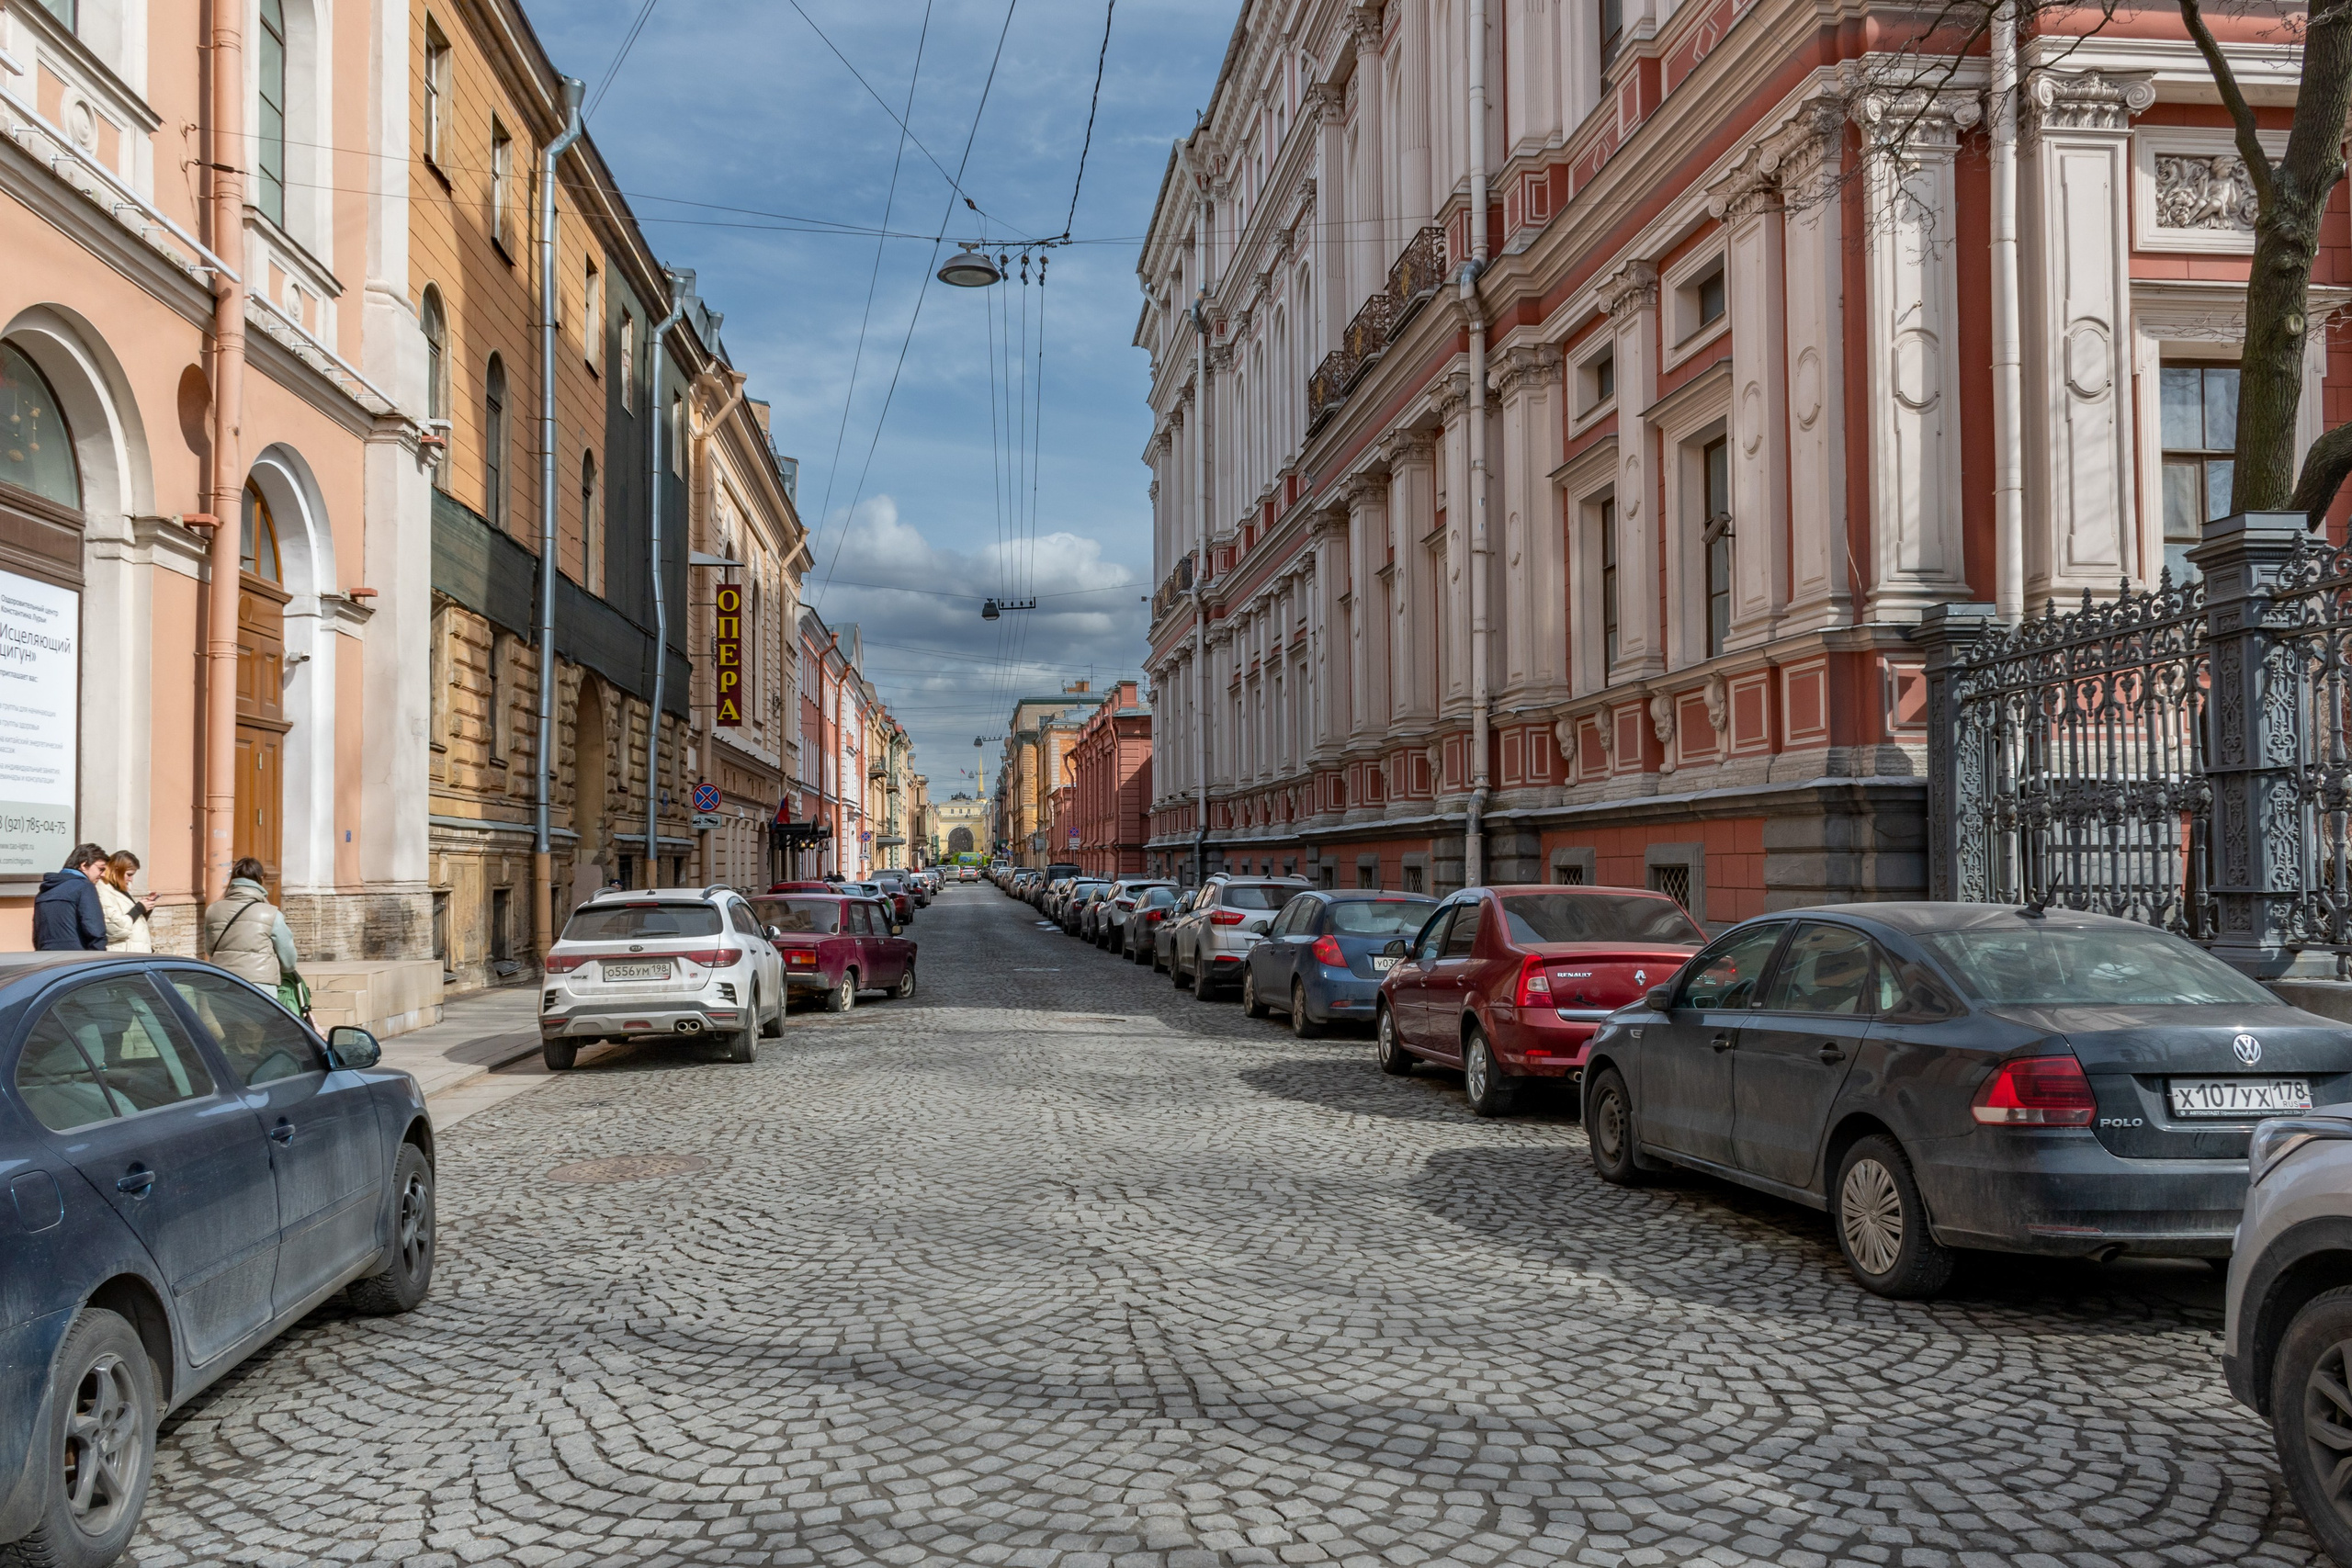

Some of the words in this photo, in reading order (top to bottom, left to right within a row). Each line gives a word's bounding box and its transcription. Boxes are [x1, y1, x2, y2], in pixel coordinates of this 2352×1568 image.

[1, 605, 32, 620] Константина
[0, 622, 71, 654] Исцеляющий
[718, 590, 741, 720] ОПЕРА
[5, 815, 25, 833] (921)
[26, 817, 66, 835] 785-04-75
[651, 964, 667, 973] 198
[2273, 1081, 2306, 1100] 178
[2099, 1118, 2143, 1128] POLO
